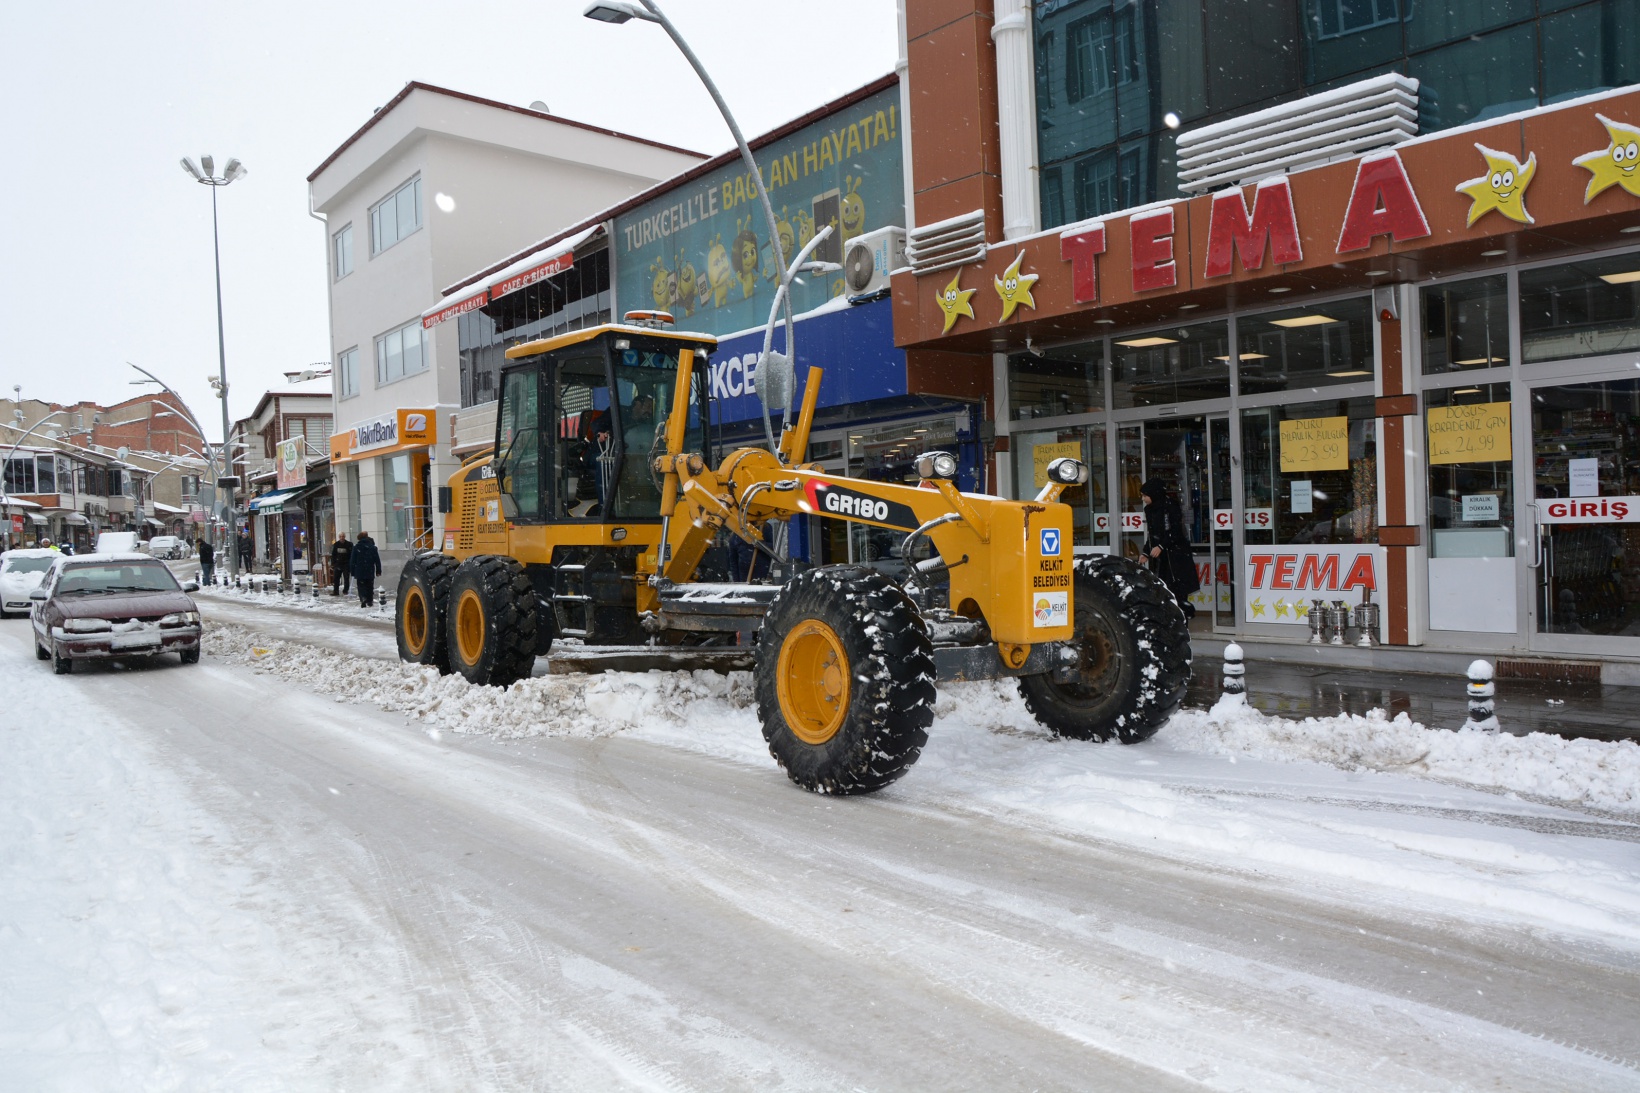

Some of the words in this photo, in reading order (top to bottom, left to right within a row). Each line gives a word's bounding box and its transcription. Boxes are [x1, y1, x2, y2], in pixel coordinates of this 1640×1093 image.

[803, 105, 897, 176] HAYATA!
[1059, 149, 1432, 303] TEMA
[502, 277, 522, 294] CAFE
[522, 274, 531, 288] &
[641, 351, 679, 369] XCM
[1295, 419, 1323, 430] DURU
[825, 492, 888, 520] GR180
[1548, 499, 1629, 520] GİRİŞ
[1040, 558, 1063, 571] KELKİT
[1195, 562, 1231, 586] MA
[1249, 553, 1377, 592] TEMA
[1033, 573, 1070, 588] BELEDİYESİ
[1052, 602, 1067, 611] KELKİT
